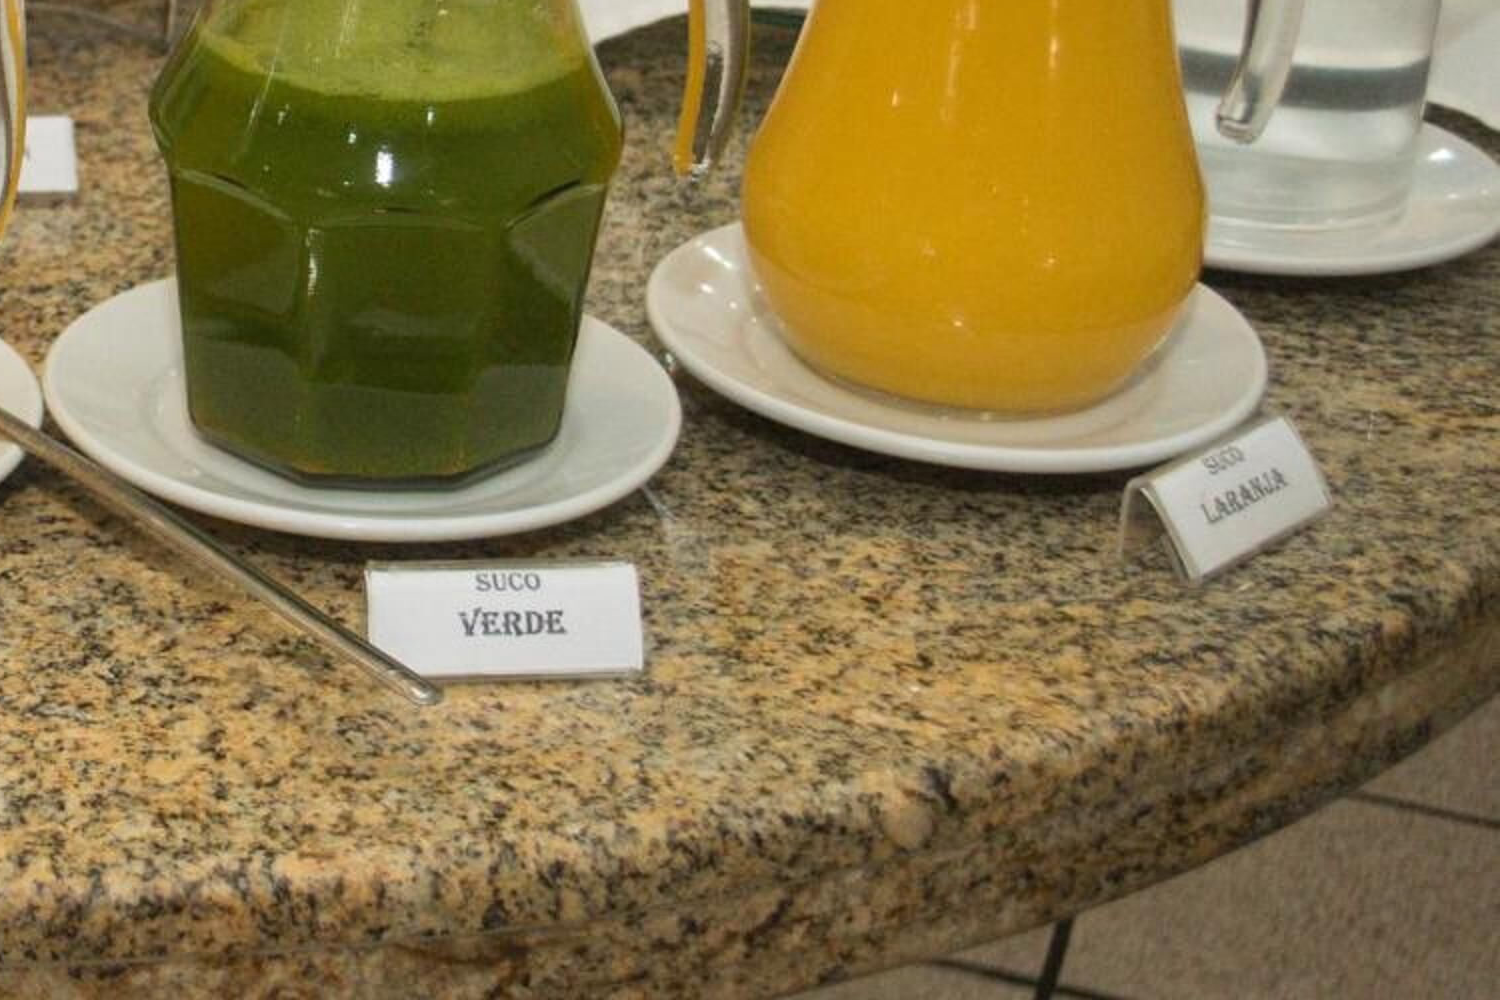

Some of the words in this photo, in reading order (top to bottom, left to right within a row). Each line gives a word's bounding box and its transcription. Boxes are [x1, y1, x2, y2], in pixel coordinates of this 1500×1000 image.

[1201, 467, 1288, 525] LARANJA
[475, 573, 541, 592] SUCO
[459, 608, 567, 637] VERDE
